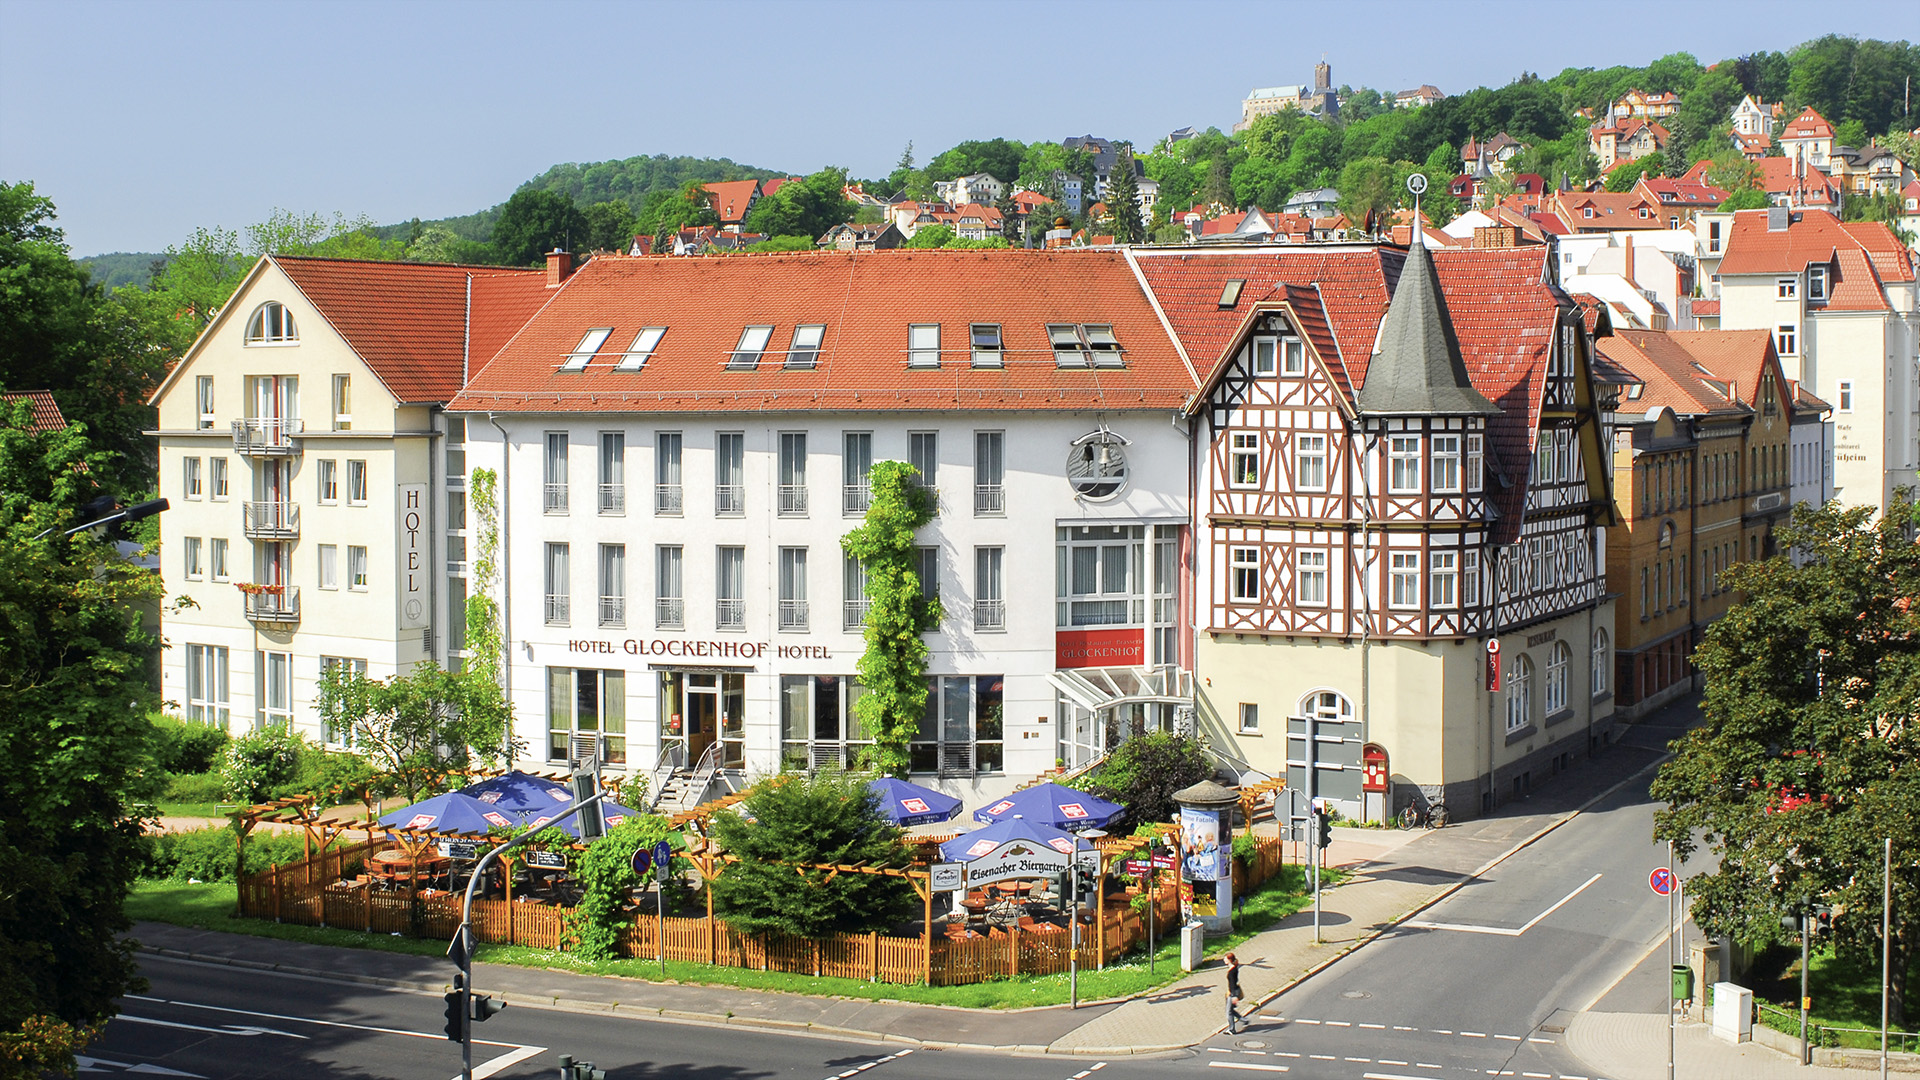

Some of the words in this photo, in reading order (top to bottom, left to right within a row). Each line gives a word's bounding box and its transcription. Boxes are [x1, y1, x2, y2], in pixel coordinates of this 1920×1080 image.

[1833, 453, 1866, 463] üheim
[405, 490, 420, 592] HOTEL
[568, 639, 615, 654] HOTEL
[623, 639, 769, 658] GLOCKENHOF
[778, 645, 832, 659] HOTEL
[1062, 646, 1141, 658] GLOCKENHOF
[969, 861, 1017, 881] Eisenacher
[1018, 859, 1067, 874] Biergarten
